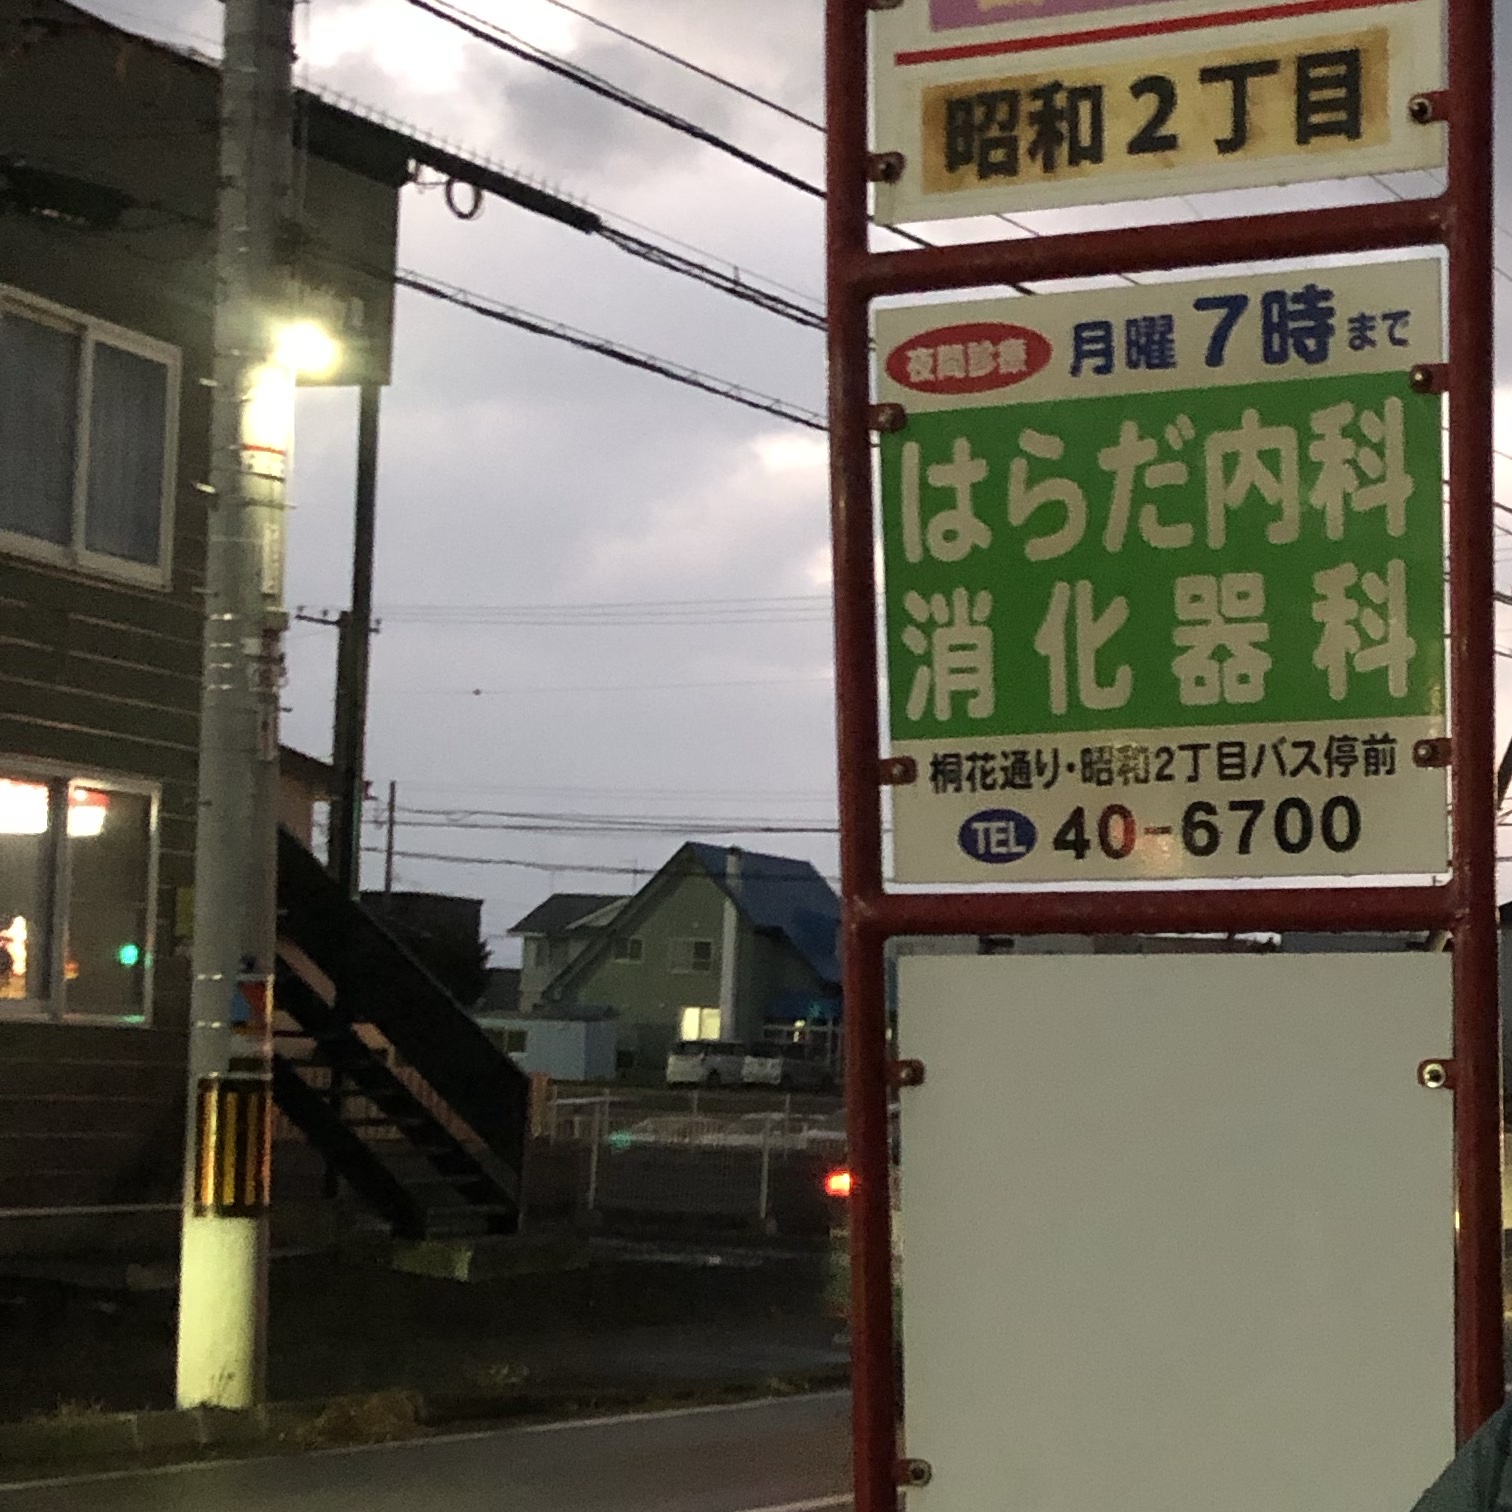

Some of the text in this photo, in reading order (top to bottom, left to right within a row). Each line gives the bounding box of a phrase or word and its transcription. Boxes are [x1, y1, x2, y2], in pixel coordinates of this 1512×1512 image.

[943, 47, 1363, 180] 昭和2丁目
[1069, 284, 1412, 377] 月曜7時まで
[902, 394, 1415, 564] はらだ内科
[902, 557, 1417, 722] 消化器科
[970, 795, 1362, 861] TEL 40-6700
